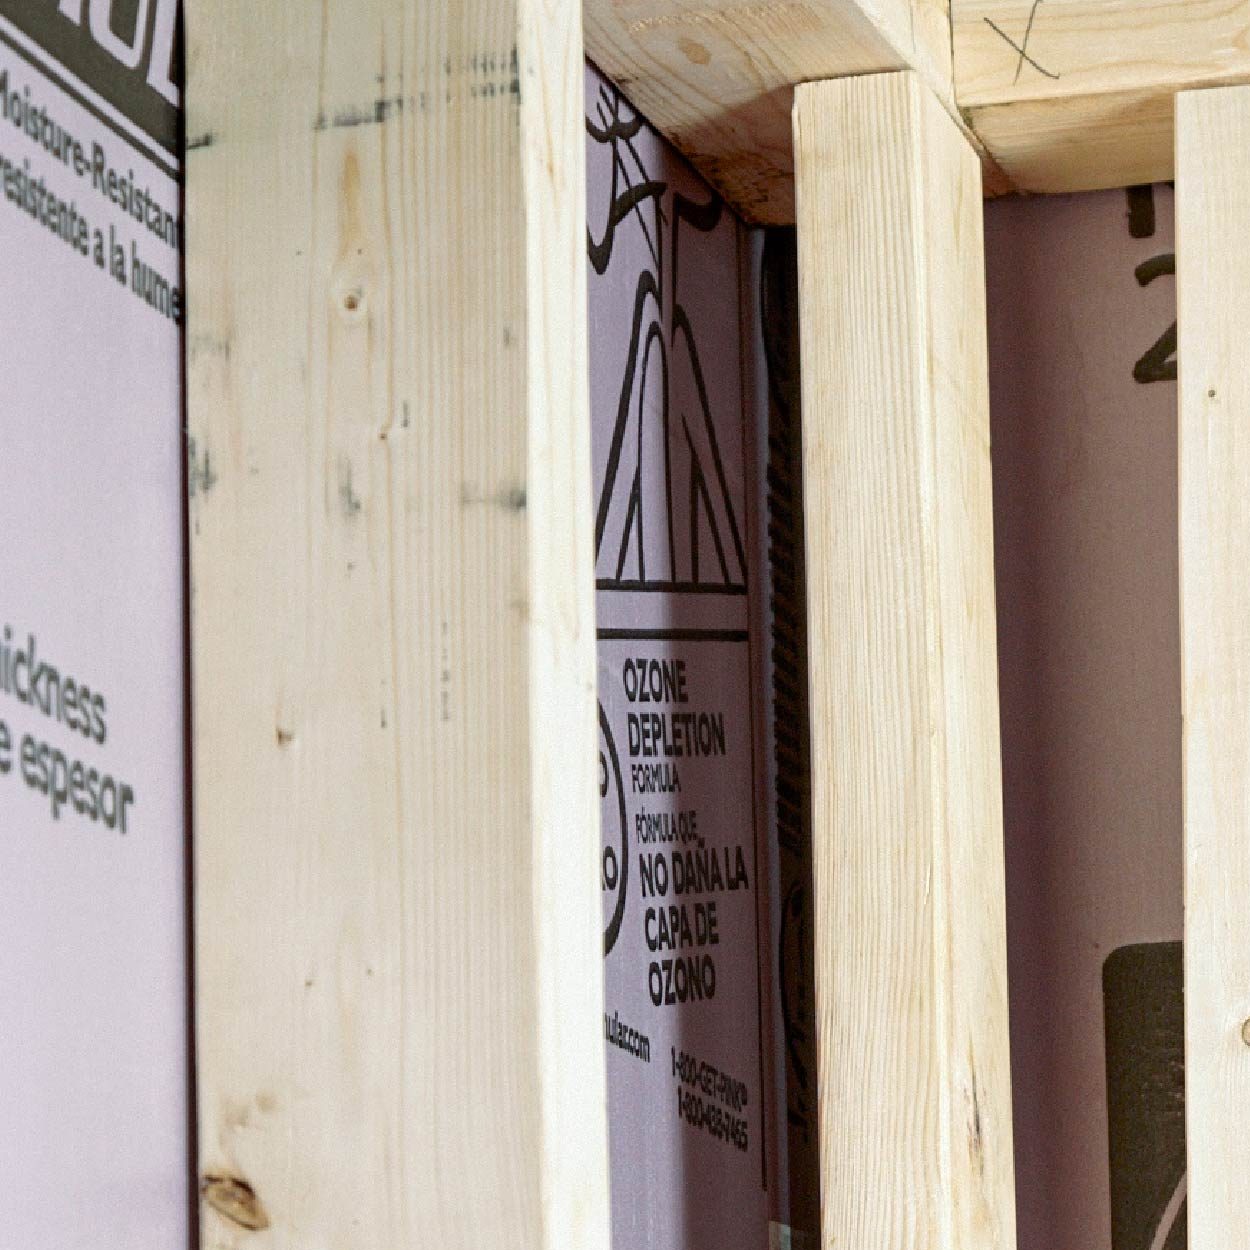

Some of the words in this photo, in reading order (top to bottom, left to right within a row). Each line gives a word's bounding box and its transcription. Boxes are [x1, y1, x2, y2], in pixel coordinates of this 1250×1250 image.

[0, 70, 179, 249] oisture-Resistan
[94, 228, 105, 269] a
[109, 224, 127, 286] la
[131, 239, 181, 325] hume
[0, 624, 107, 745] ickness
[623, 658, 689, 703] OZONE
[627, 712, 726, 758] DEPLETION
[20, 733, 134, 835] espesor
[631, 764, 682, 793] FORMULA
[639, 853, 669, 898] NO
[672, 838, 724, 894] DAÑA
[724, 846, 749, 891] LA
[645, 903, 693, 952] CAPA
[694, 902, 719, 946] DE
[648, 954, 716, 1007] OZONO
[604, 1010, 650, 1063] ular.com
